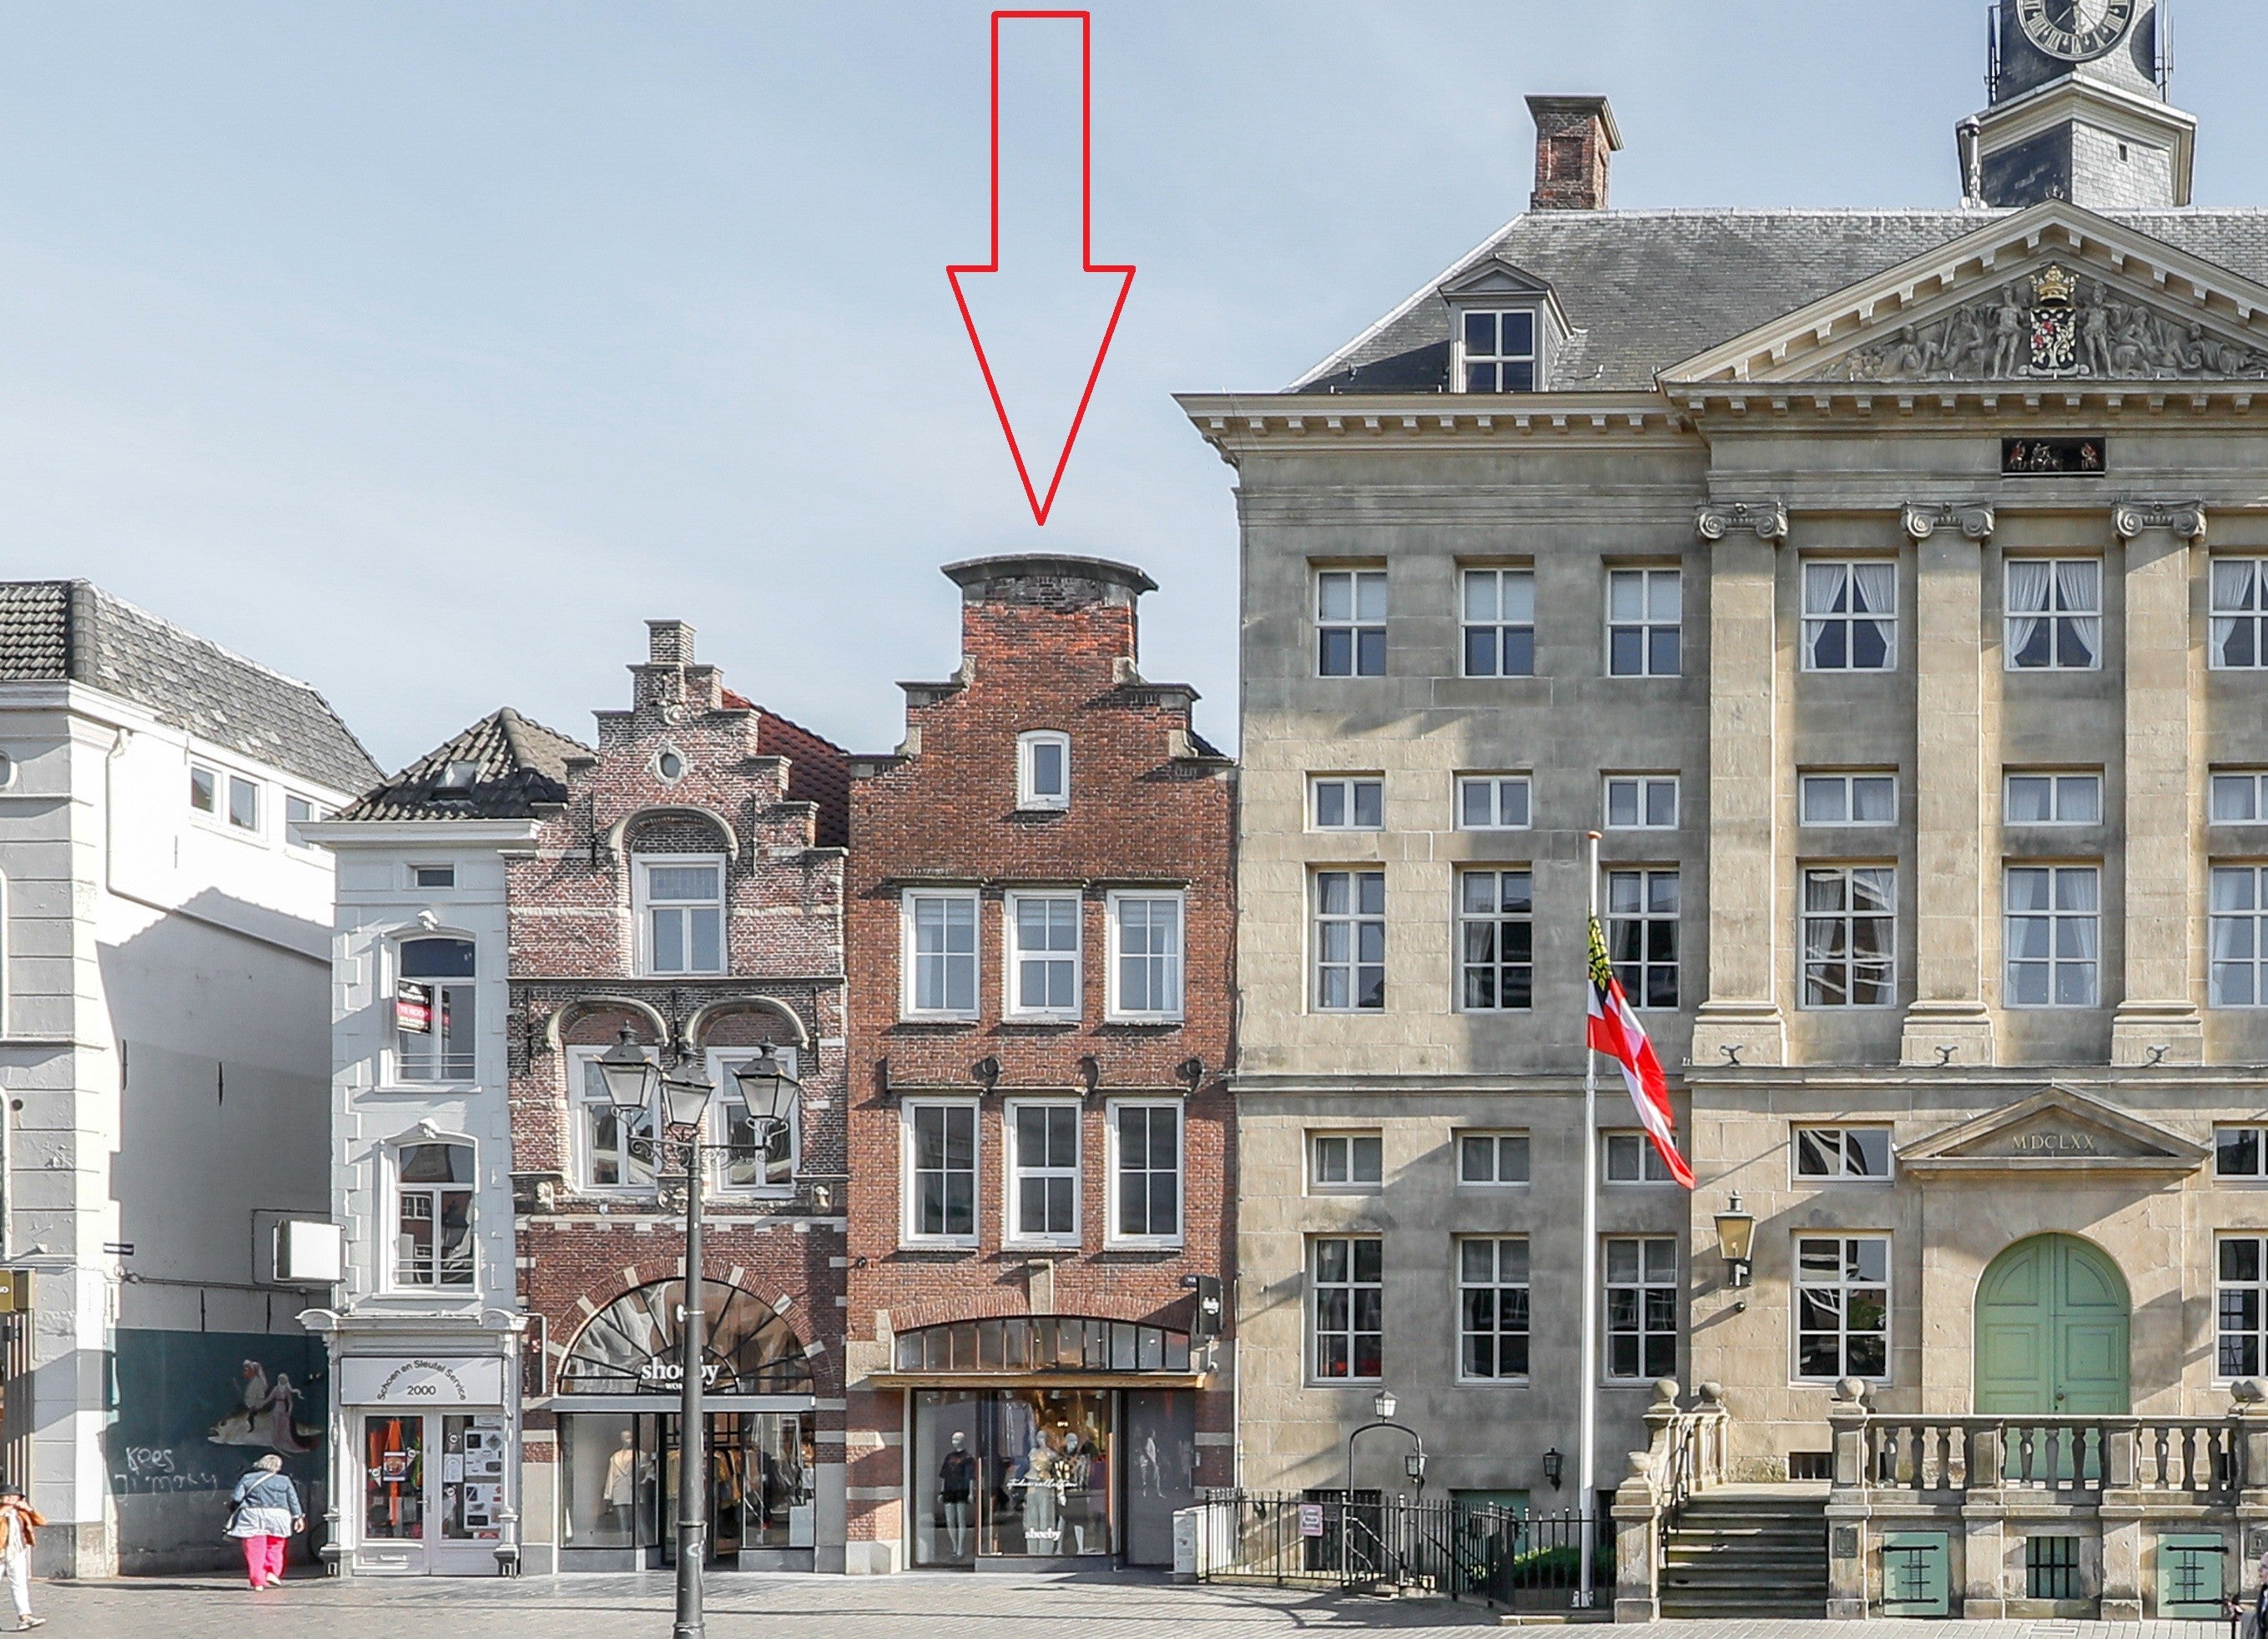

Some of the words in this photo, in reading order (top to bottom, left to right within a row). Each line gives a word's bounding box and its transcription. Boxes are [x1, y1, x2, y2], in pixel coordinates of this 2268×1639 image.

[2012, 1135, 2094, 1150] MDCLXX
[377, 1369, 401, 1400] Schoen
[401, 1363, 413, 1373] en
[414, 1360, 446, 1373] Sleutel
[445, 1369, 466, 1400] Service
[407, 1385, 436, 1395] 2000
